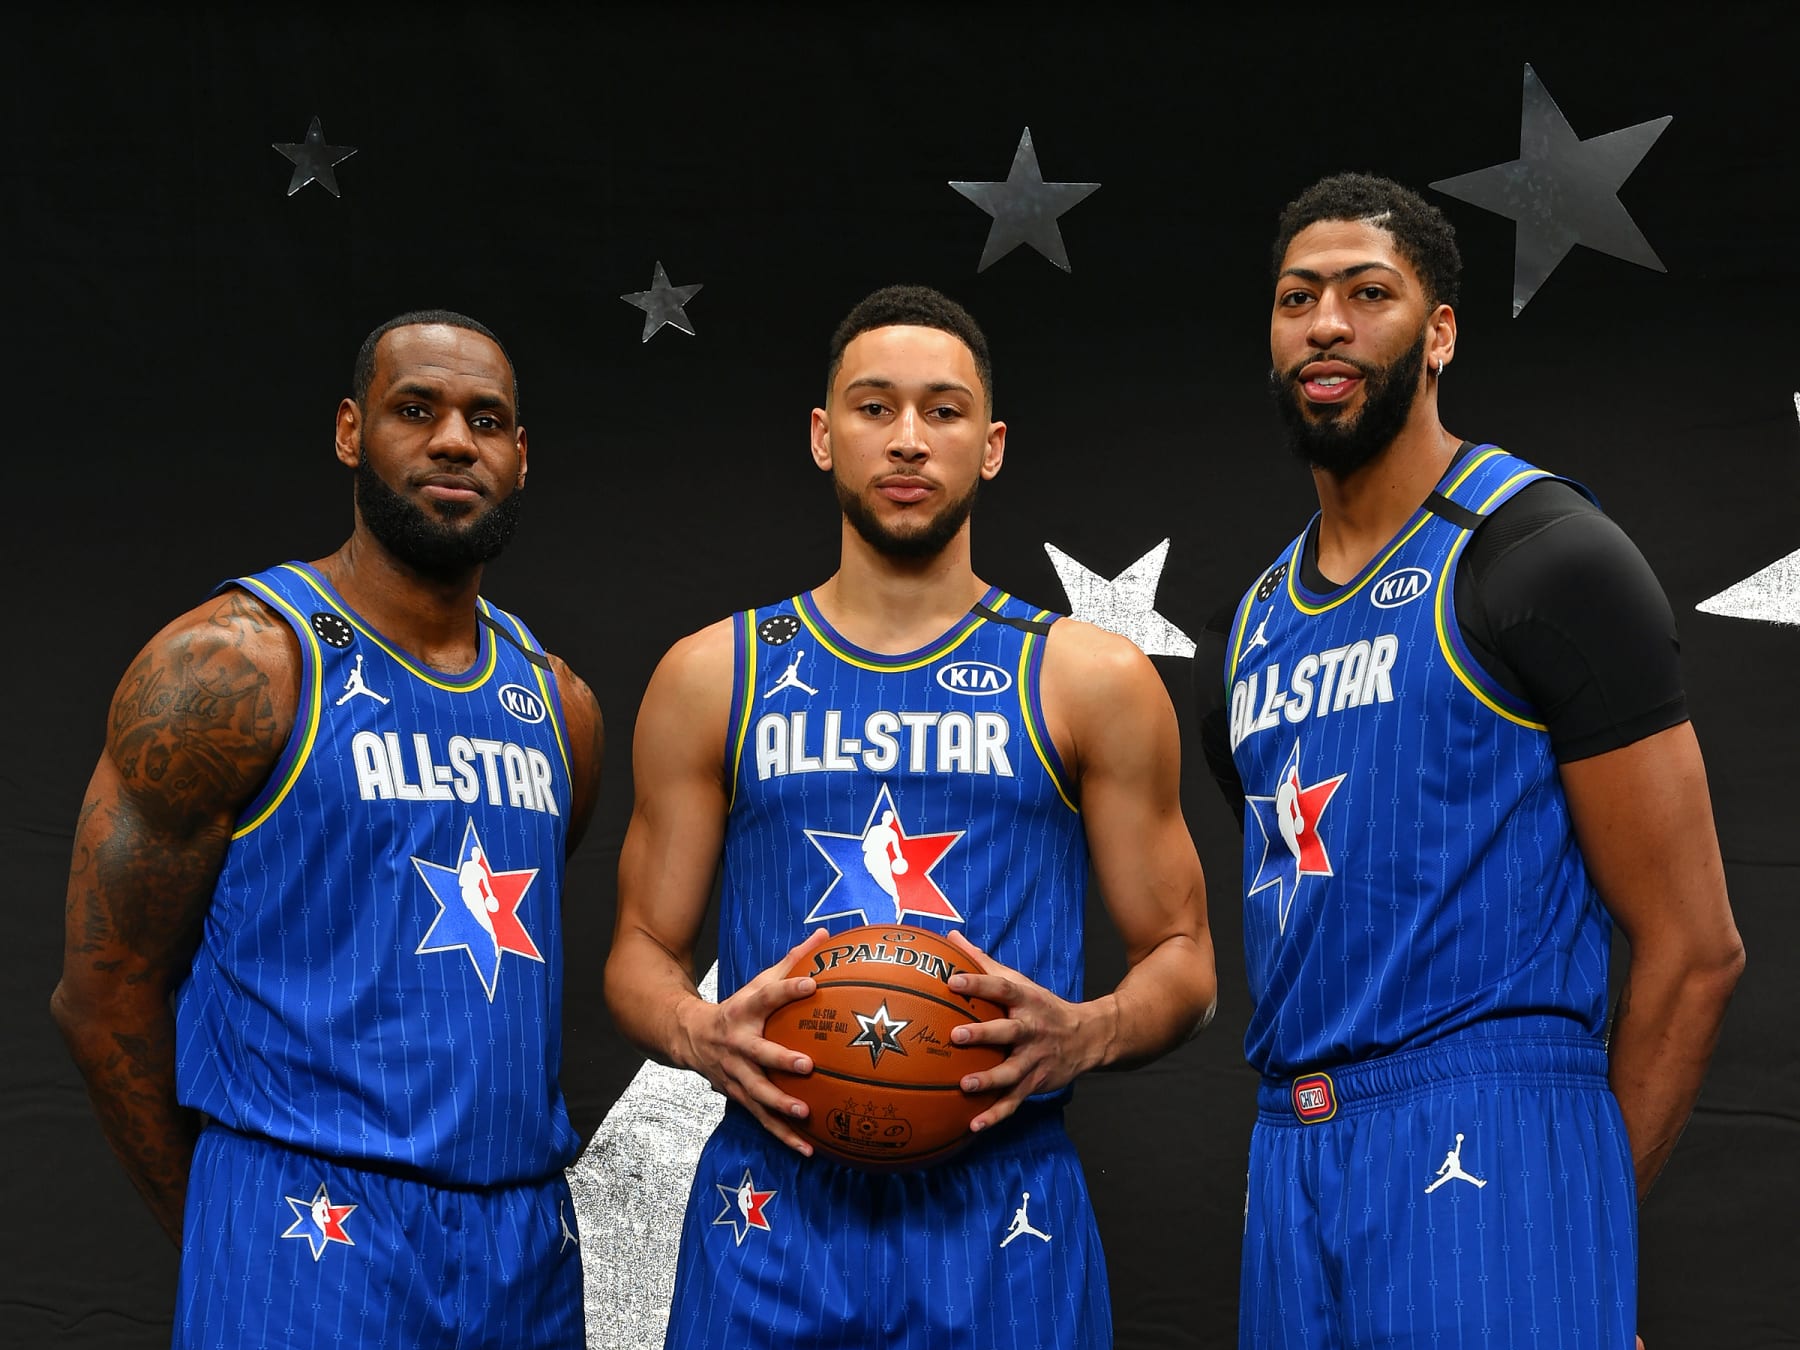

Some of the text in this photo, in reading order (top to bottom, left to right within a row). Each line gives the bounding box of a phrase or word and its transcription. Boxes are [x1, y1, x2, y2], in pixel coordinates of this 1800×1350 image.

[949, 668, 1000, 690] KIA
[1230, 633, 1398, 755] ALL-STAR
[351, 731, 560, 816] ALL-STAR
[755, 710, 1014, 781] ALL-STAR
